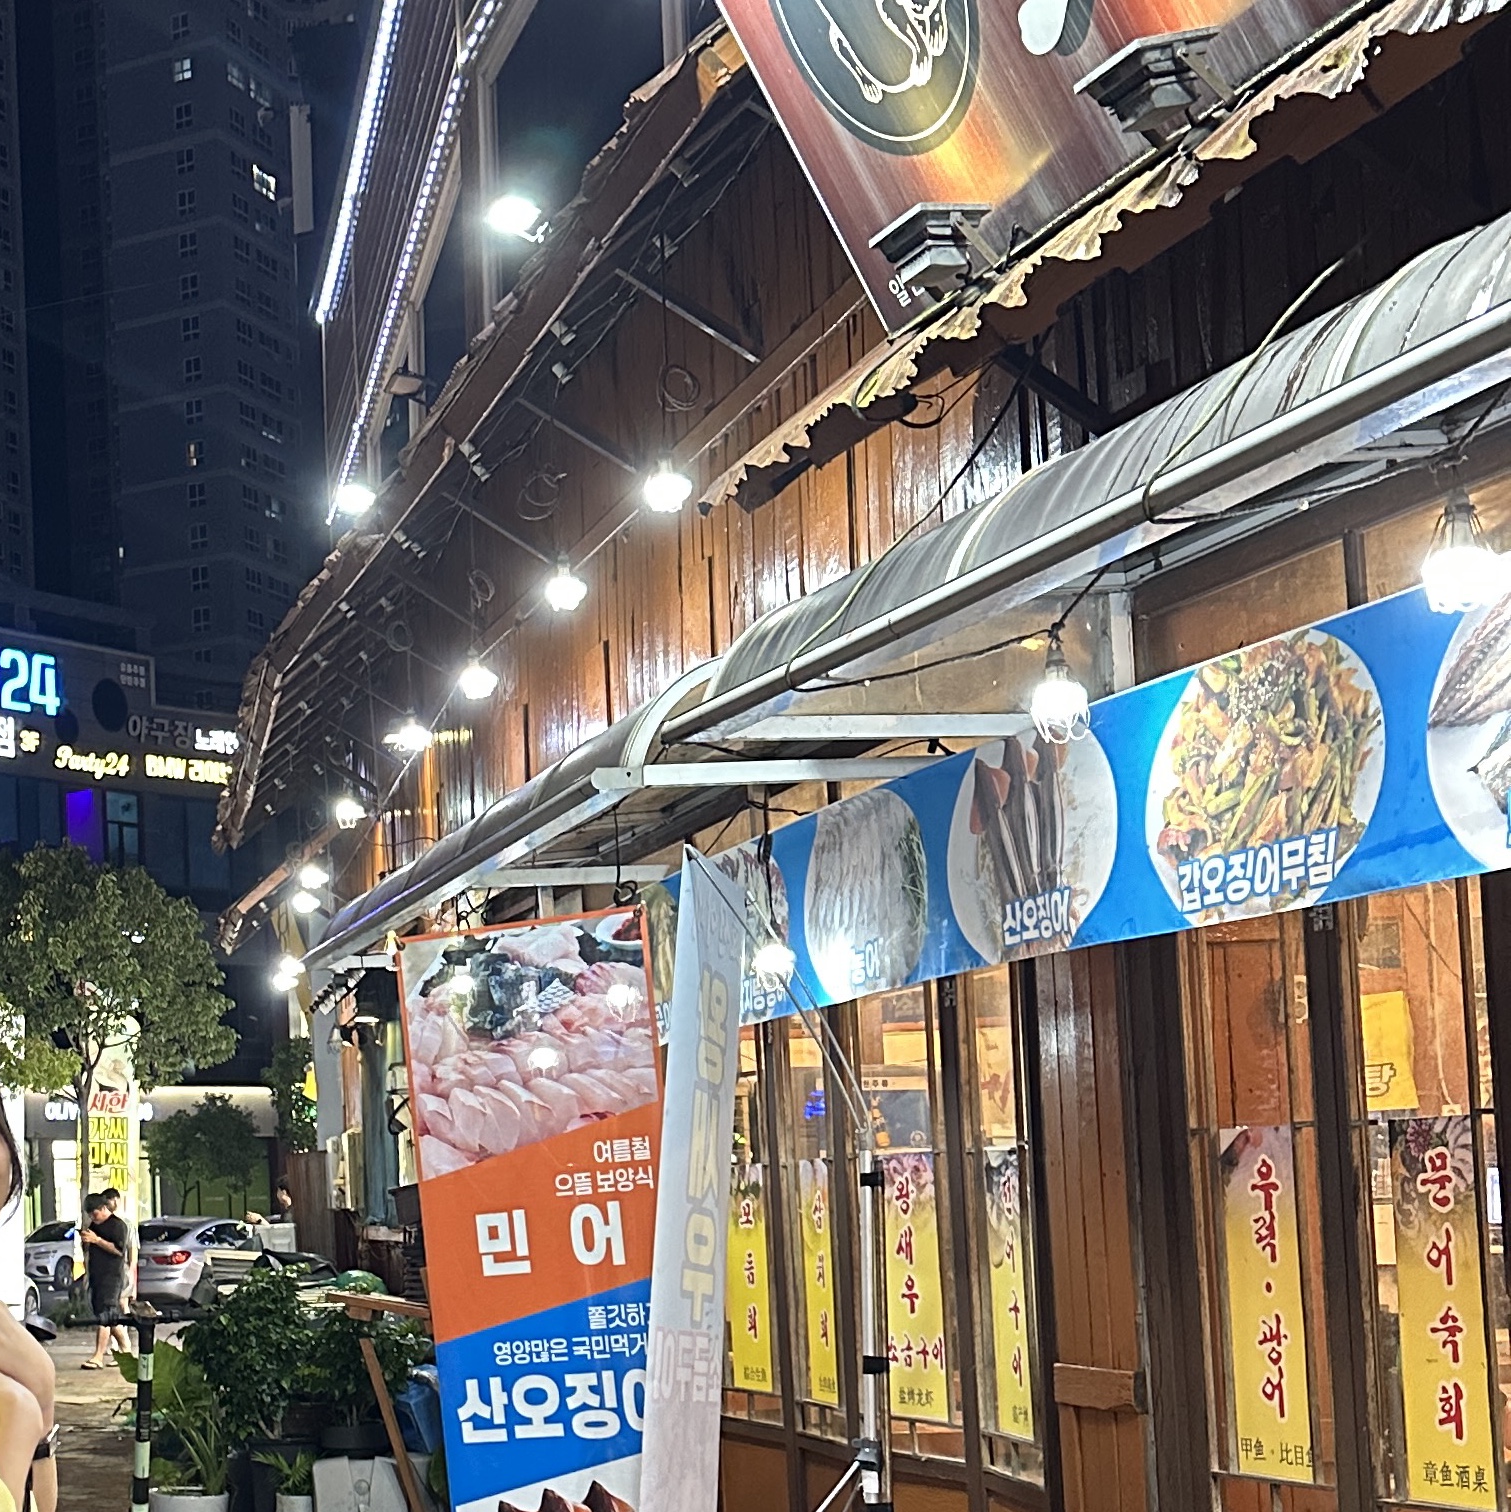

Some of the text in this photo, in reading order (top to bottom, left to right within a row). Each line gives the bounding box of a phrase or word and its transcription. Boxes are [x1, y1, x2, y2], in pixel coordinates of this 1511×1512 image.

[888, 273, 926, 308] 일
[127, 714, 194, 748] 야구장
[1178, 829, 1337, 913] 갑오징어무침
[1002, 888, 1070, 946] 산오징어
[593, 1136, 651, 1164] 여름철
[555, 1165, 654, 1197] 으뜸 보양식
[475, 1200, 627, 1276] 민 어
[895, 1175, 920, 1316] 왕새우
[1251, 1159, 1288, 1419] 우럭 광어
[1419, 1150, 1464, 1442] 문어숙회
[493, 1338, 569, 1366] 영양많은
